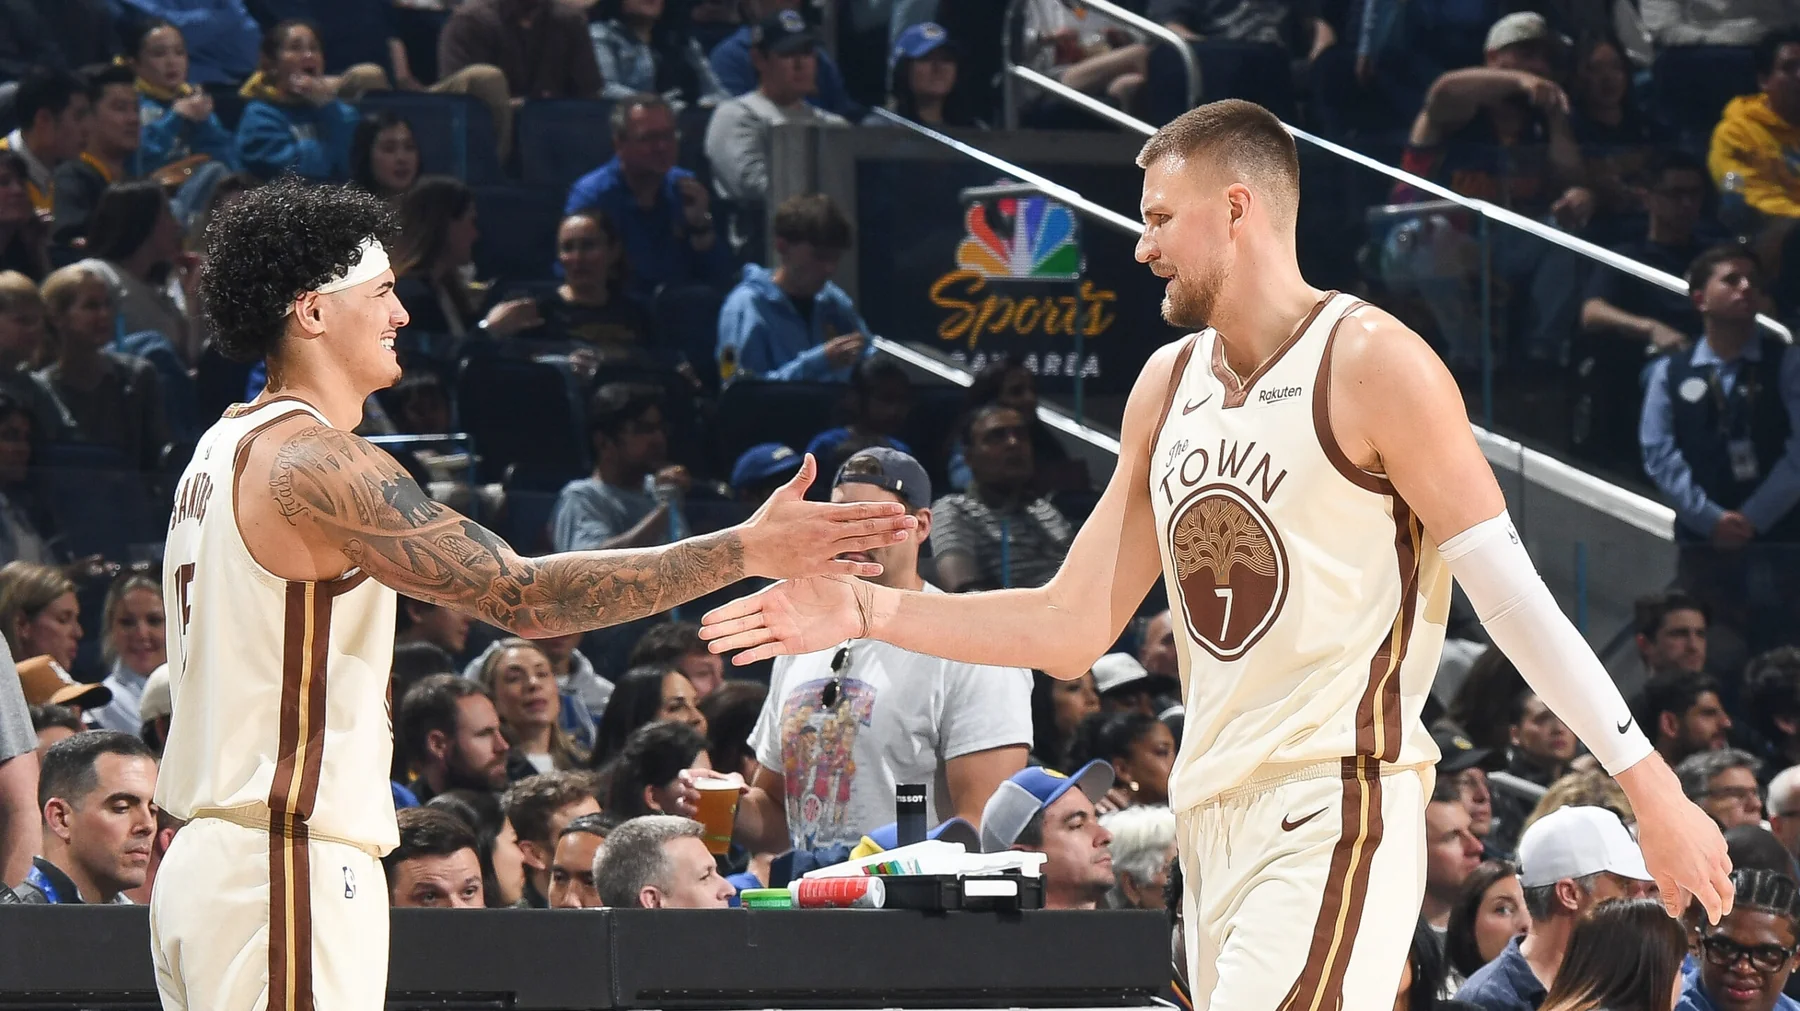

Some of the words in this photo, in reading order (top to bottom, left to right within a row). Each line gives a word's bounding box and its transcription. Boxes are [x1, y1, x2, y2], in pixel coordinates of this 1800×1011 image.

[929, 269, 1117, 350] Sports
[1023, 352, 1101, 378] AREA
[1259, 386, 1302, 404] Rakuten
[1159, 438, 1288, 507] TOWN
[1165, 438, 1189, 468] The
[1213, 588, 1233, 642] 7
